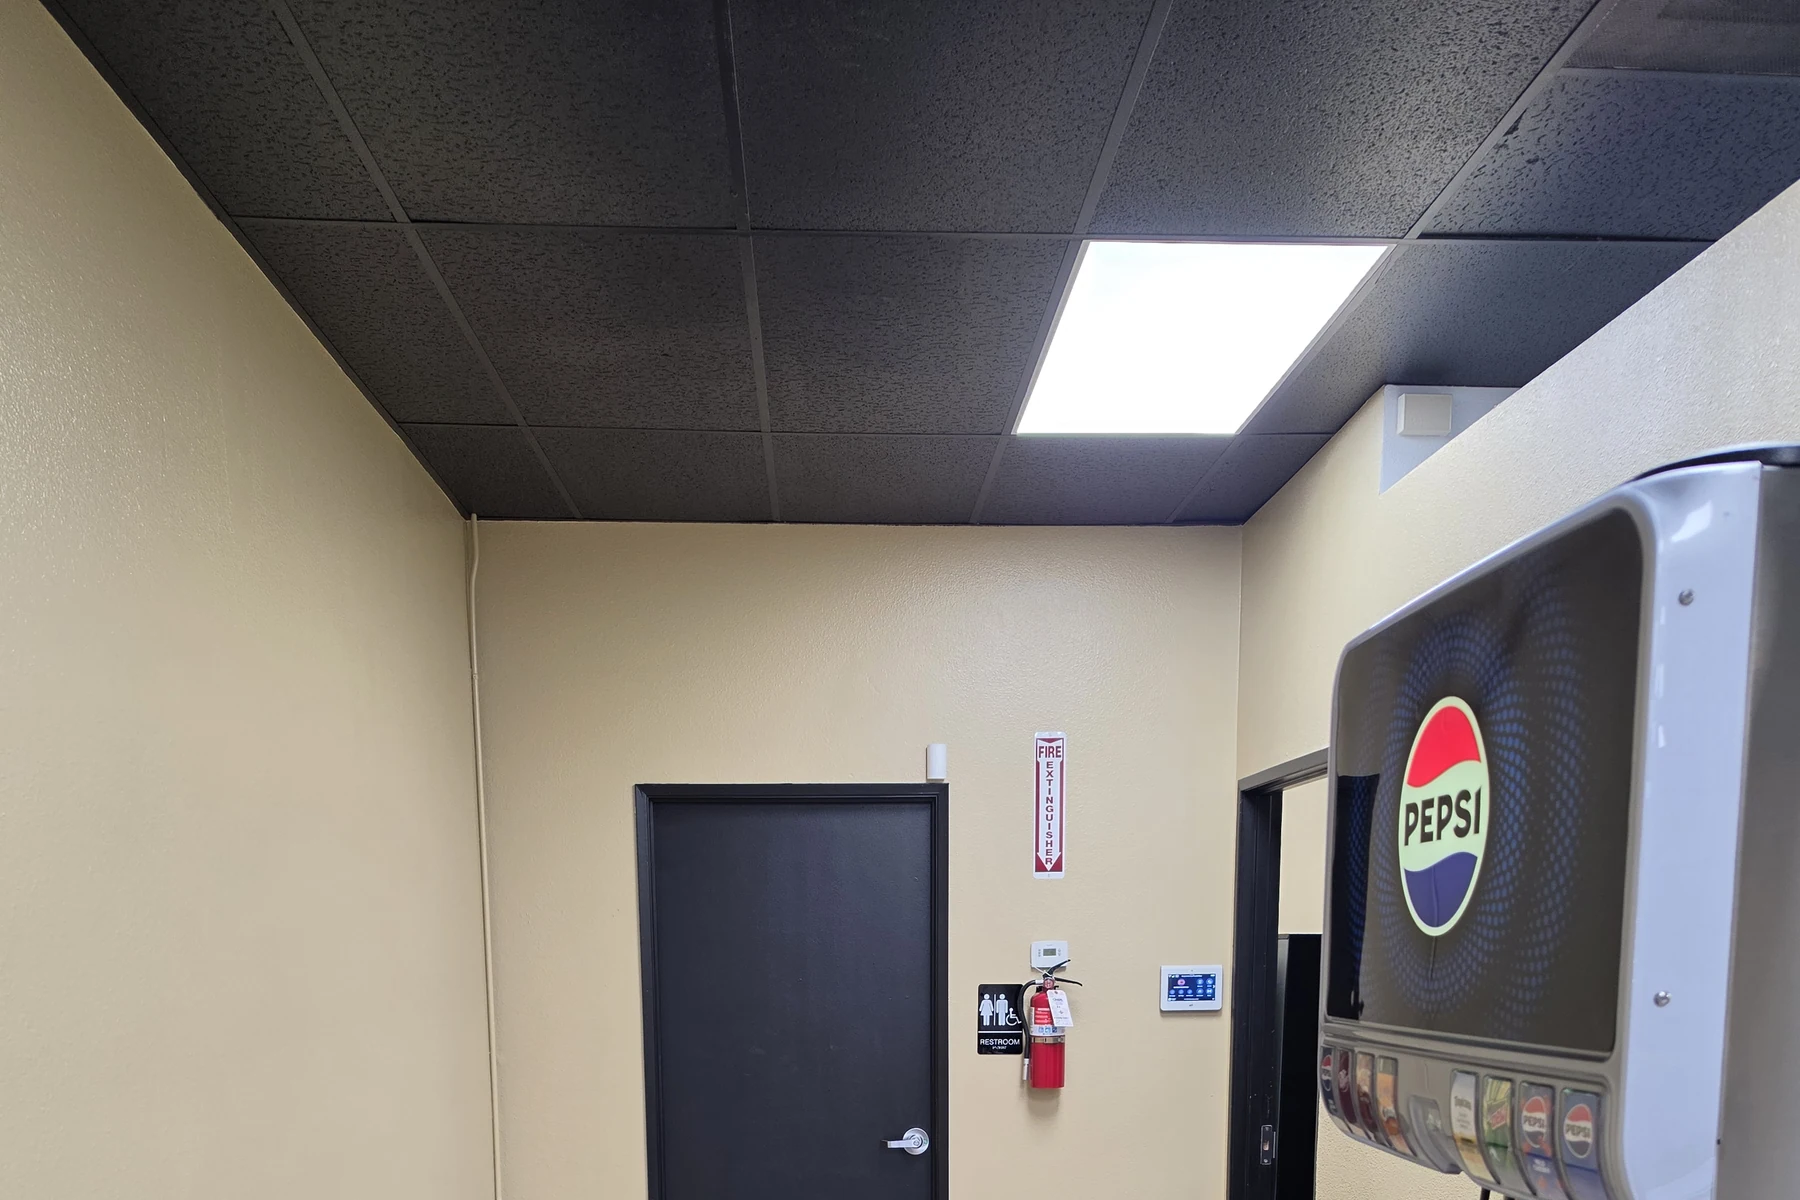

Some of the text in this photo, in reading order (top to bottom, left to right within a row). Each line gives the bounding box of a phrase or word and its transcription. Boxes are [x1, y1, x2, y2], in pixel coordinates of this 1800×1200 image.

[1038, 745, 1062, 759] FIRE
[1045, 761, 1054, 865] EXTINGUISHER
[1404, 786, 1482, 846] PEPSI
[980, 1038, 1021, 1046] RESTROOM
[1523, 1114, 1546, 1129] PEPSI
[1565, 1123, 1592, 1139] PEPSI
